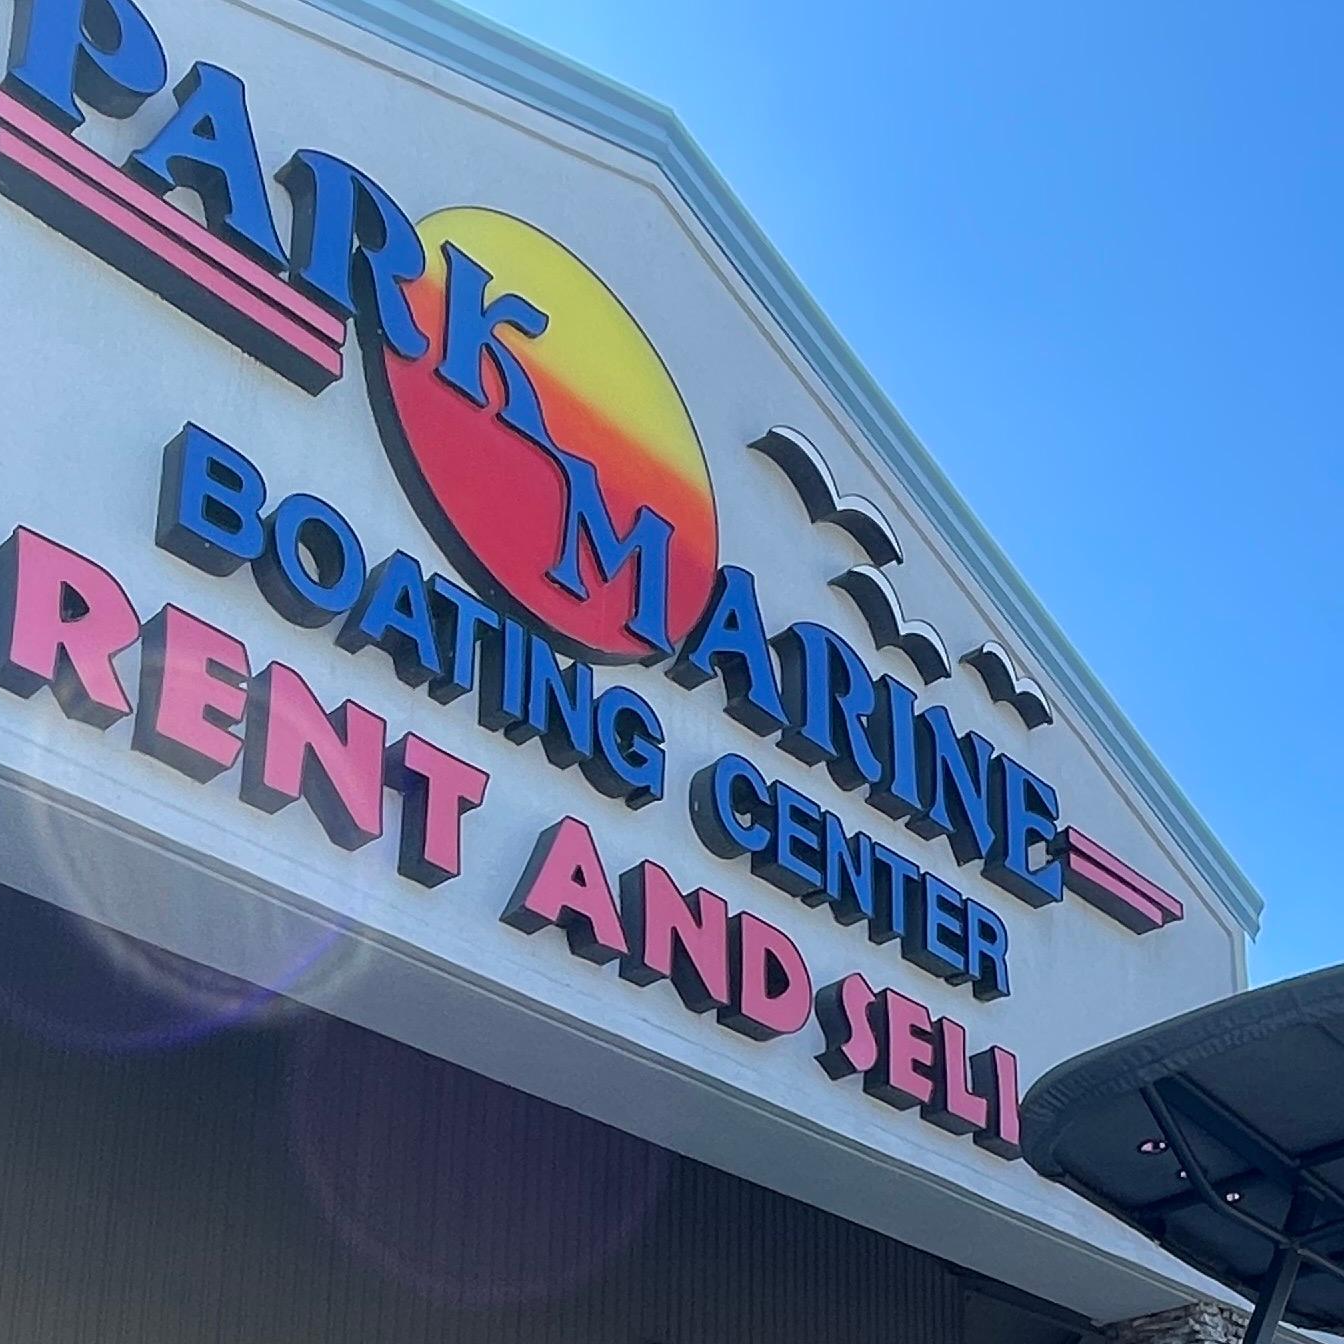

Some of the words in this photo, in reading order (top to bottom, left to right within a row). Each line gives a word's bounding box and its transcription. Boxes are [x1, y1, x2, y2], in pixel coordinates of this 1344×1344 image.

[3, 0, 549, 437] PARK
[547, 453, 1063, 904] MARINE
[159, 421, 664, 807] BOATING
[692, 754, 1010, 1000] CENTER
[502, 816, 813, 1040] AND
